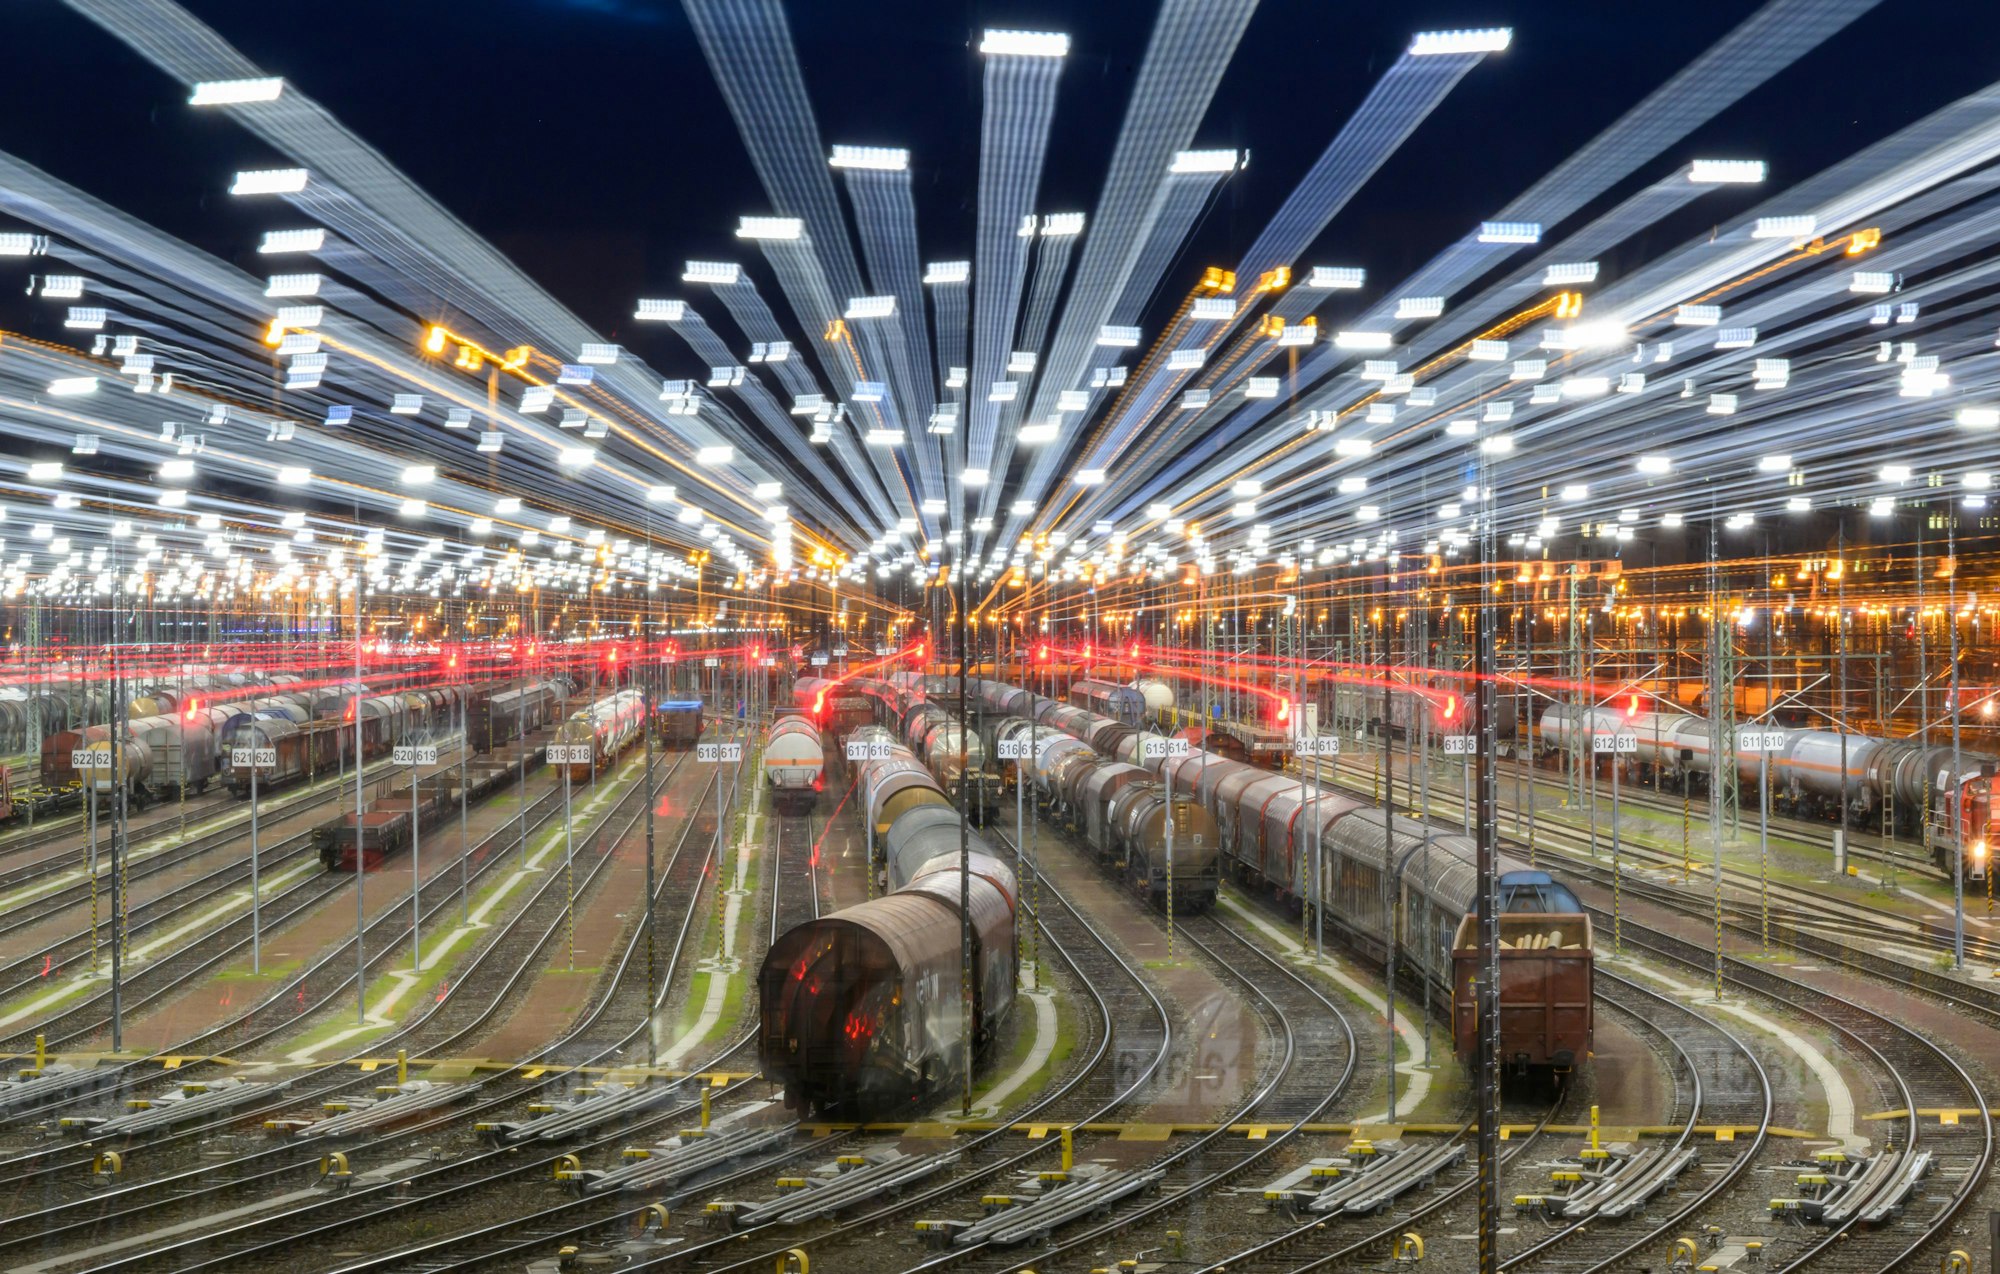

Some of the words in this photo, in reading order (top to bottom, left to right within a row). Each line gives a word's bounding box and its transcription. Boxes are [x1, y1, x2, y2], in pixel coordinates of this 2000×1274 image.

[1296, 740, 1315, 751] 614
[1319, 740, 1338, 751] 613
[1445, 739, 1464, 751] 613
[1594, 737, 1614, 749] 612
[1618, 737, 1636, 748] 611
[1742, 736, 1760, 747] 611
[1764, 735, 1783, 747] 610
[698, 747, 718, 759] 618
[721, 747, 740, 758] 617
[848, 745, 867, 756] 617
[870, 745, 890, 756] 616
[1000, 744, 1018, 755] 616
[1146, 743, 1165, 754] 615
[1168, 742, 1188, 753] 614
[73, 753, 92, 765] 622
[96, 753, 111, 765] 62
[233, 752, 252, 763] 621
[255, 752, 275, 763] 620
[394, 750, 413, 761] 620
[416, 750, 436, 761] 619
[547, 749, 567, 760] 619
[570, 749, 590, 760] 618
